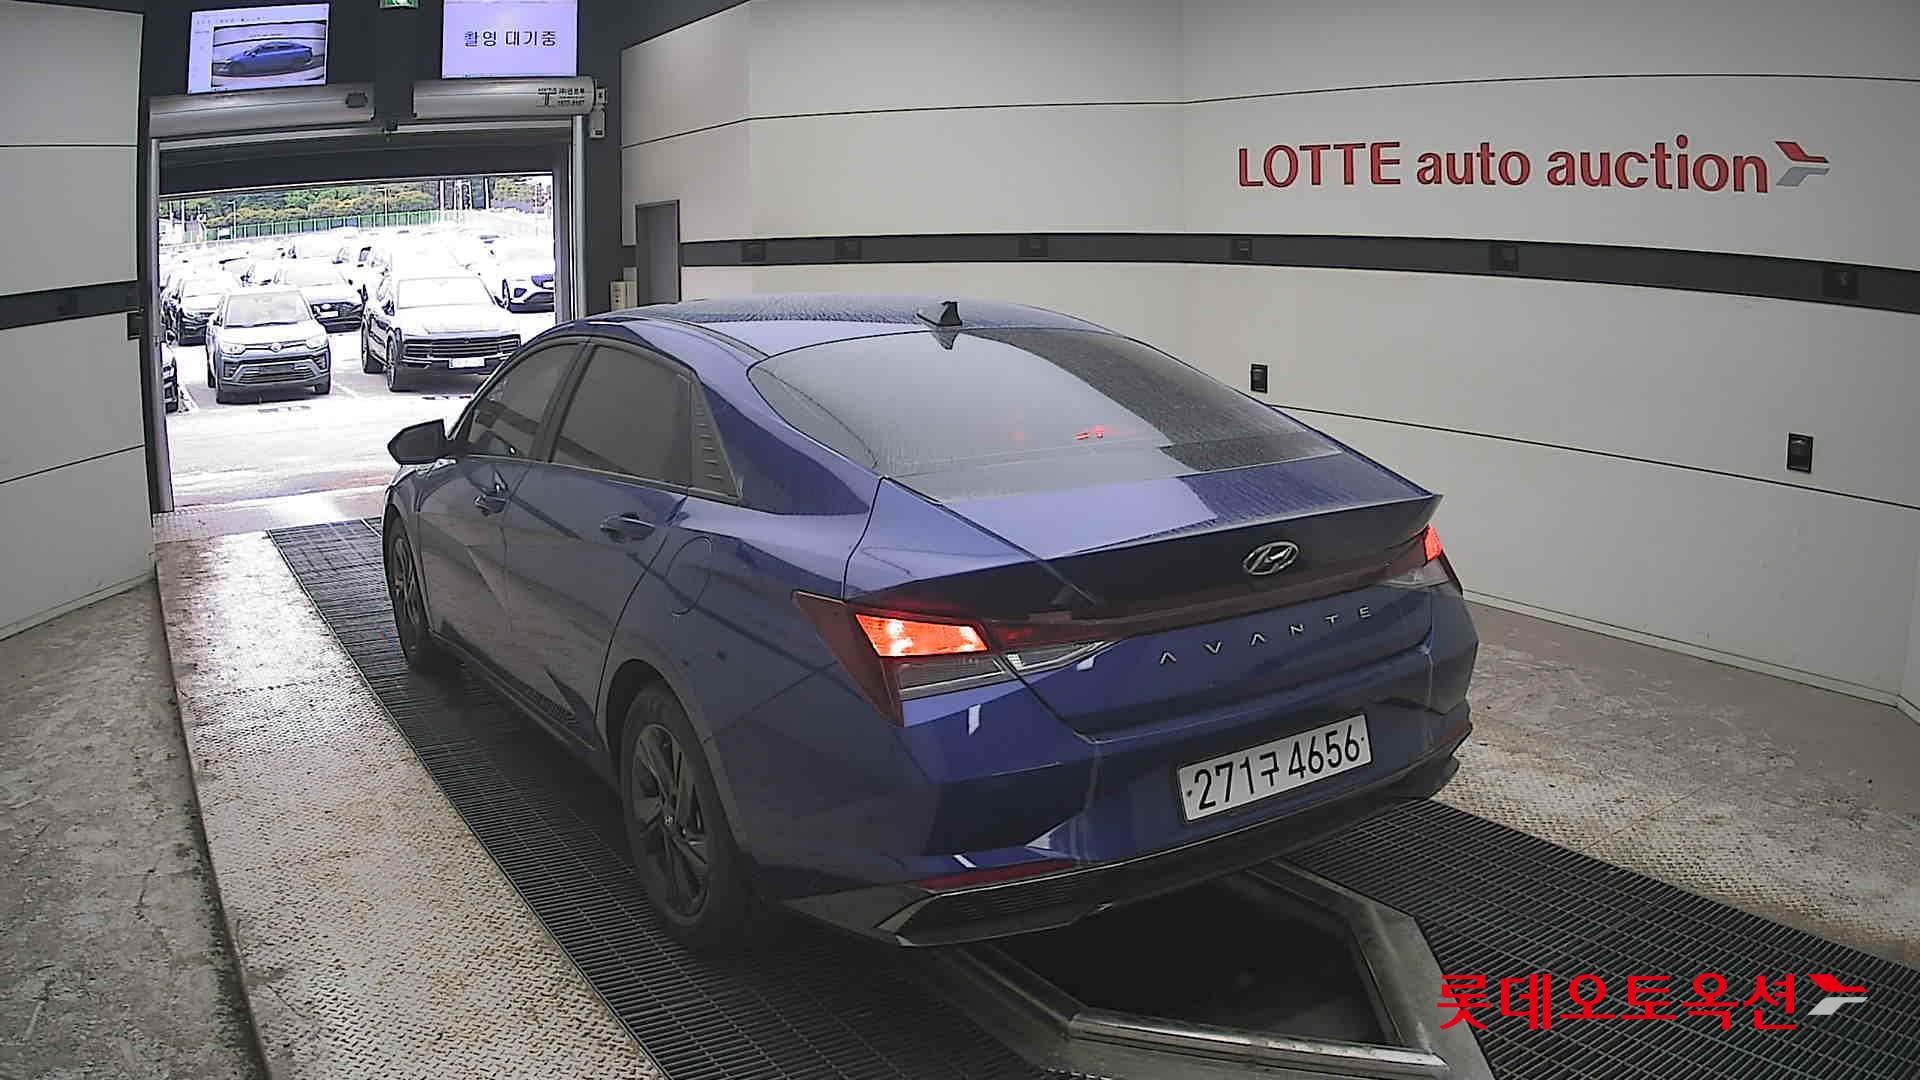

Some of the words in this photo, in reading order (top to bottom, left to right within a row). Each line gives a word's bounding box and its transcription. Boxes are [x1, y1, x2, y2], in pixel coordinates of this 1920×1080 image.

[505, 30, 556, 47] 대기중
[1238, 140, 1401, 188] LOTTE
[1416, 141, 1531, 187] auto
[1546, 133, 1770, 194] auction
[1159, 605, 1372, 665] AVANTE
